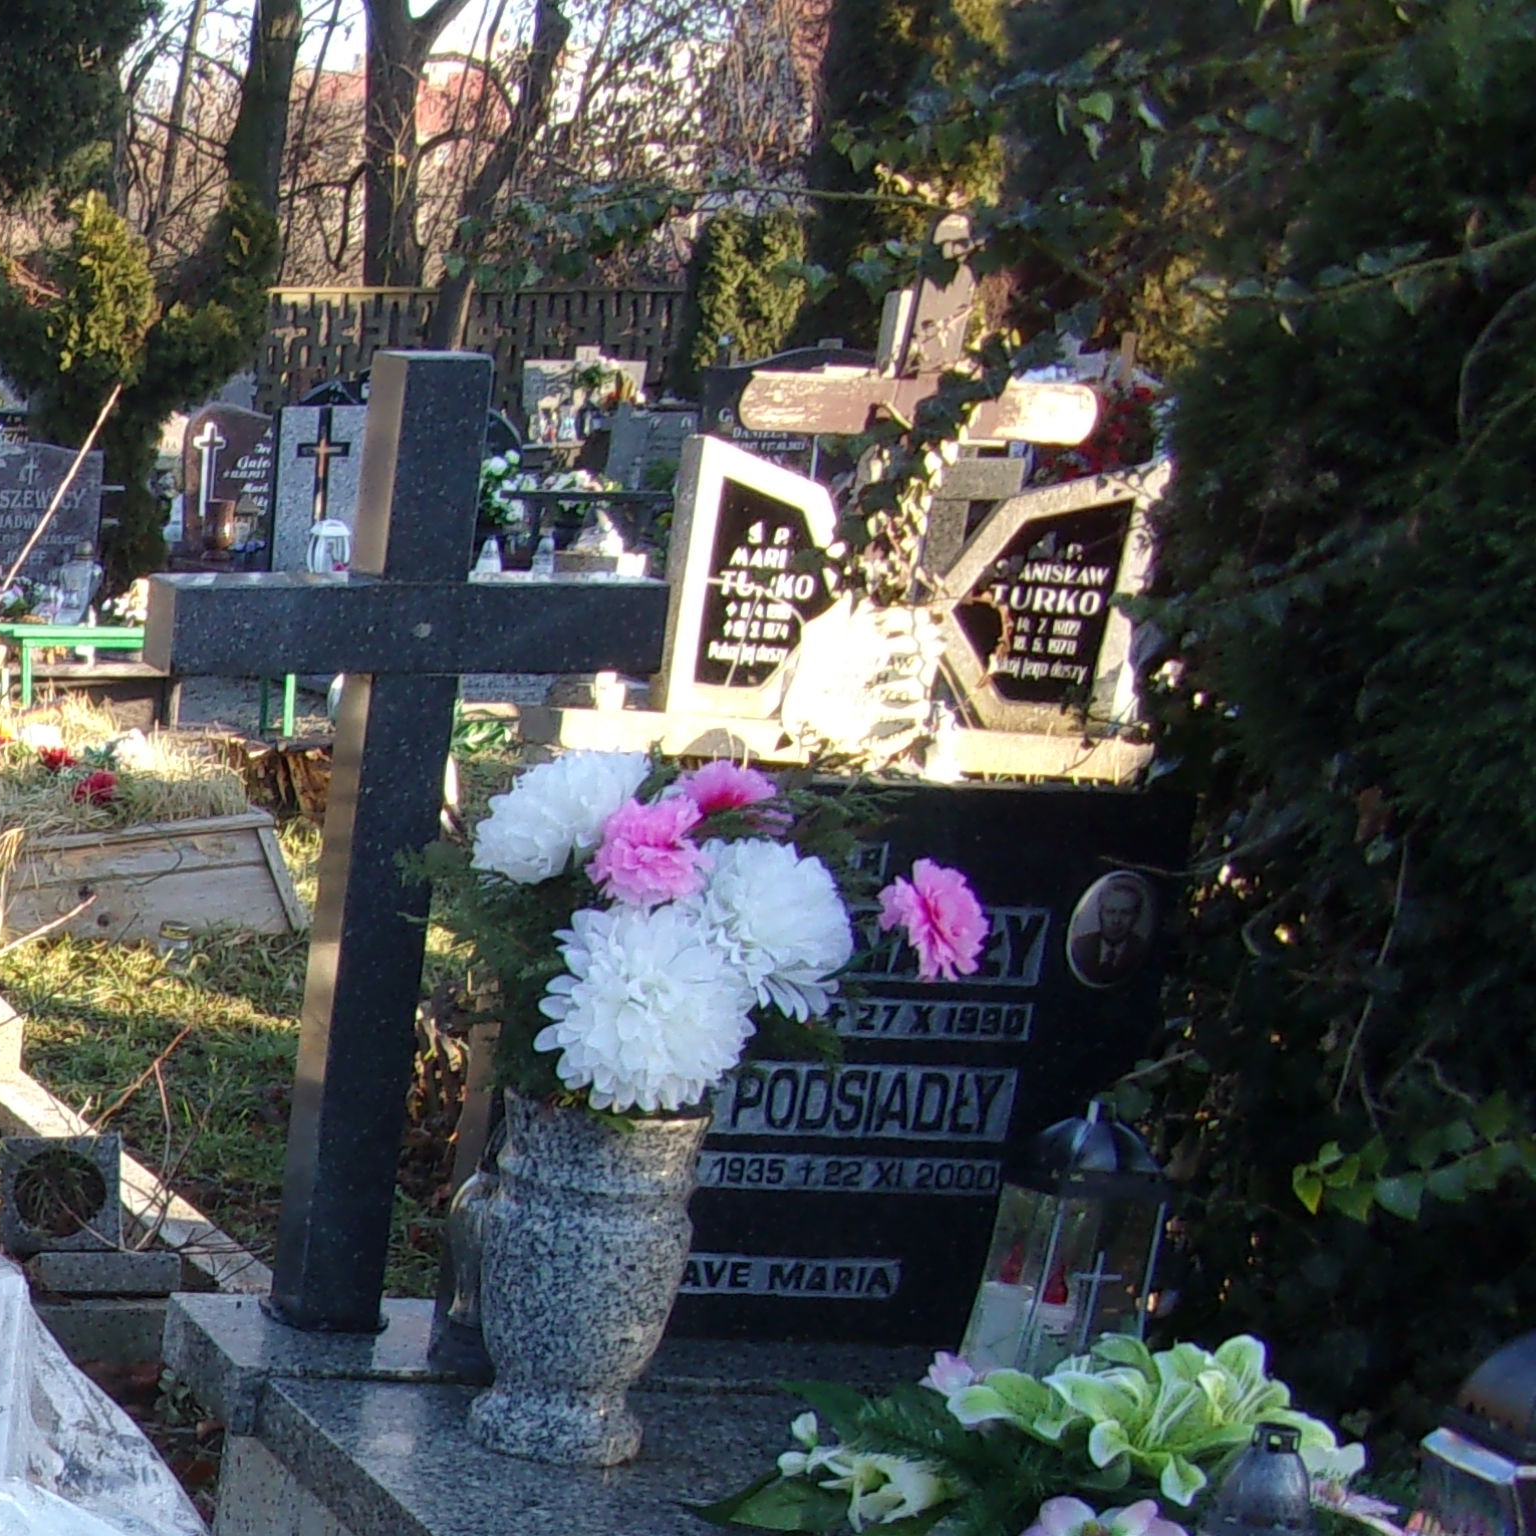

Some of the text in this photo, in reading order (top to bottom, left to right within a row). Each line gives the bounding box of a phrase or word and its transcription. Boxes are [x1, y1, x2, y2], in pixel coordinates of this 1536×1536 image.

[990, 584, 1102, 616] TURKO
[731, 1067, 1006, 1135] PODSIADŁY
[715, 1156, 787, 1185] 1935
[824, 1158, 863, 1187] 22
[915, 1162, 997, 1191] 2000
[683, 1260, 893, 1294] AVE MARIA
